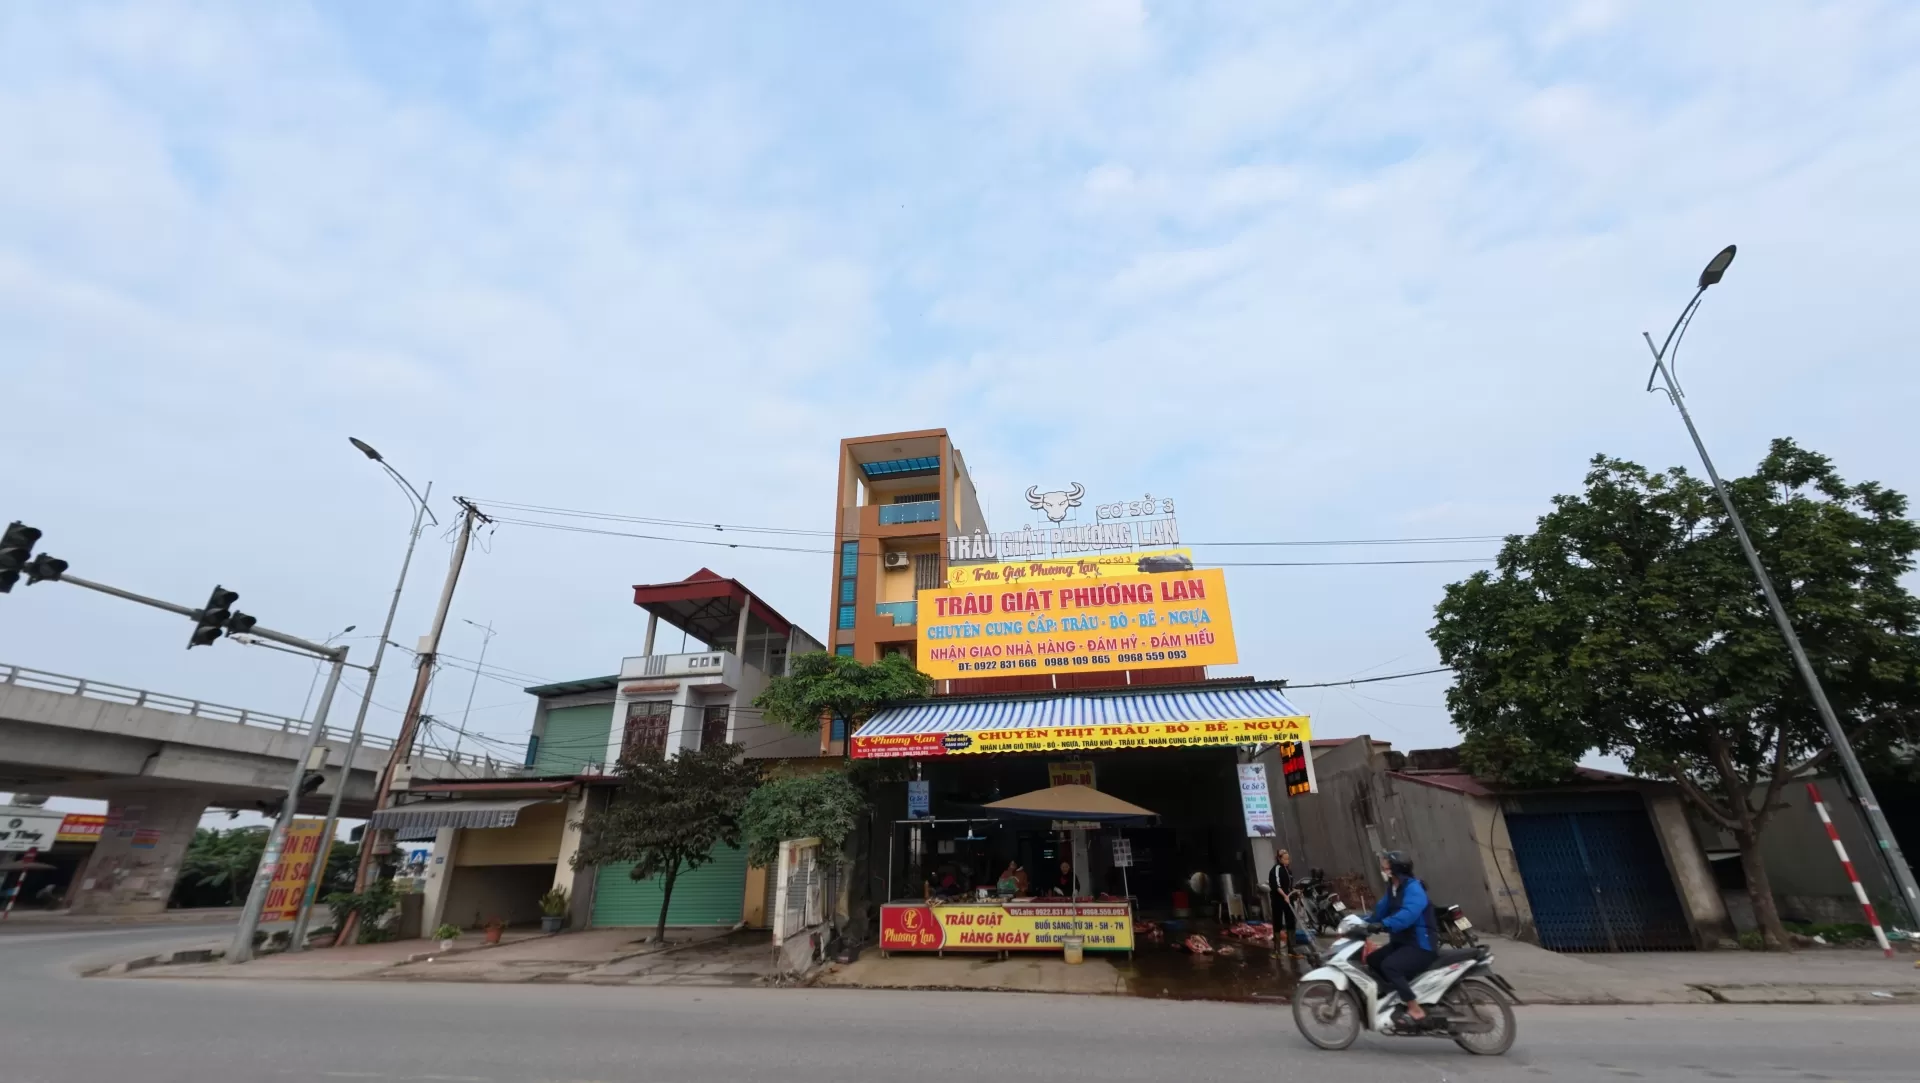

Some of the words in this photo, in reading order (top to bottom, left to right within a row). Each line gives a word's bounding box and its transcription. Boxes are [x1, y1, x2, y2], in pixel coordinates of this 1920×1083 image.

[1097, 501, 1124, 520] CƠ
[1129, 492, 1156, 516] SỞ
[1163, 498, 1174, 514] 3
[947, 528, 997, 560] TRÂU
[1001, 524, 1045, 561] GIẬT
[1050, 522, 1132, 554] PHƯƠNG
[1136, 518, 1179, 546] LAN
[972, 567, 999, 581] Trâu
[1030, 563, 1075, 578] Phương
[1077, 560, 1098, 576] Lan
[935, 592, 992, 617] TRÂU
[1001, 588, 1053, 616] GIẬT
[1060, 582, 1154, 609] PHƯƠNG
[1160, 578, 1206, 602] LAN
[928, 621, 980, 640] CHUYÊN
[986, 622, 1023, 636] CUNG
[1027, 614, 1058, 633] CẤP:
[1061, 614, 1099, 632] TRÂU
[1109, 612, 1128, 630] BÒ
[1139, 610, 1157, 627] BÊ
[1168, 608, 1211, 628] NGỰA
[930, 645, 966, 662] NHẬN
[970, 645, 1002, 658] GIAO
[1006, 640, 1033, 656] NHÀ
[1038, 638, 1076, 654] HÀNG
[1087, 636, 1118, 652] ĐÁM
[1121, 634, 1138, 650] HỶ
[1150, 632, 1182, 648] ĐÁM
[1185, 628, 1215, 646] HIẾU
[974, 661, 997, 670] 0922
[1000, 660, 1016, 668] 831
[1018, 658, 1037, 668] 666
[1044, 657, 1069, 666] 0988
[1072, 656, 1088, 665] 109
[1092, 655, 1110, 664] 865
[1118, 652, 1143, 662] 0968
[1146, 652, 1165, 661] 559
[1168, 650, 1187, 660] 093
[870, 735, 911, 746] Phương
[914, 734, 936, 744] Lan
[978, 728, 1049, 740] CHUYÊN
[1054, 728, 1095, 738] THỊT
[1100, 724, 1150, 736] TRÂU
[1165, 722, 1190, 734] BÒ
[1205, 721, 1229, 732] BÊ
[1244, 720, 1300, 732] NGỰA
[1148, 737, 1167, 745] NHẬN
[945, 912, 974, 926] TRÂU
[976, 912, 1004, 929] GIẬT
[1035, 920, 1051, 930] BUỔI
[1099, 922, 1108, 930] 5H
[1115, 921, 1124, 930] 7H
[885, 928, 917, 947] Phương
[919, 928, 935, 945] Lan
[960, 929, 994, 943] HÀNG
[996, 929, 1030, 944] NGÀY
[1035, 932, 1051, 943] BUỔI
